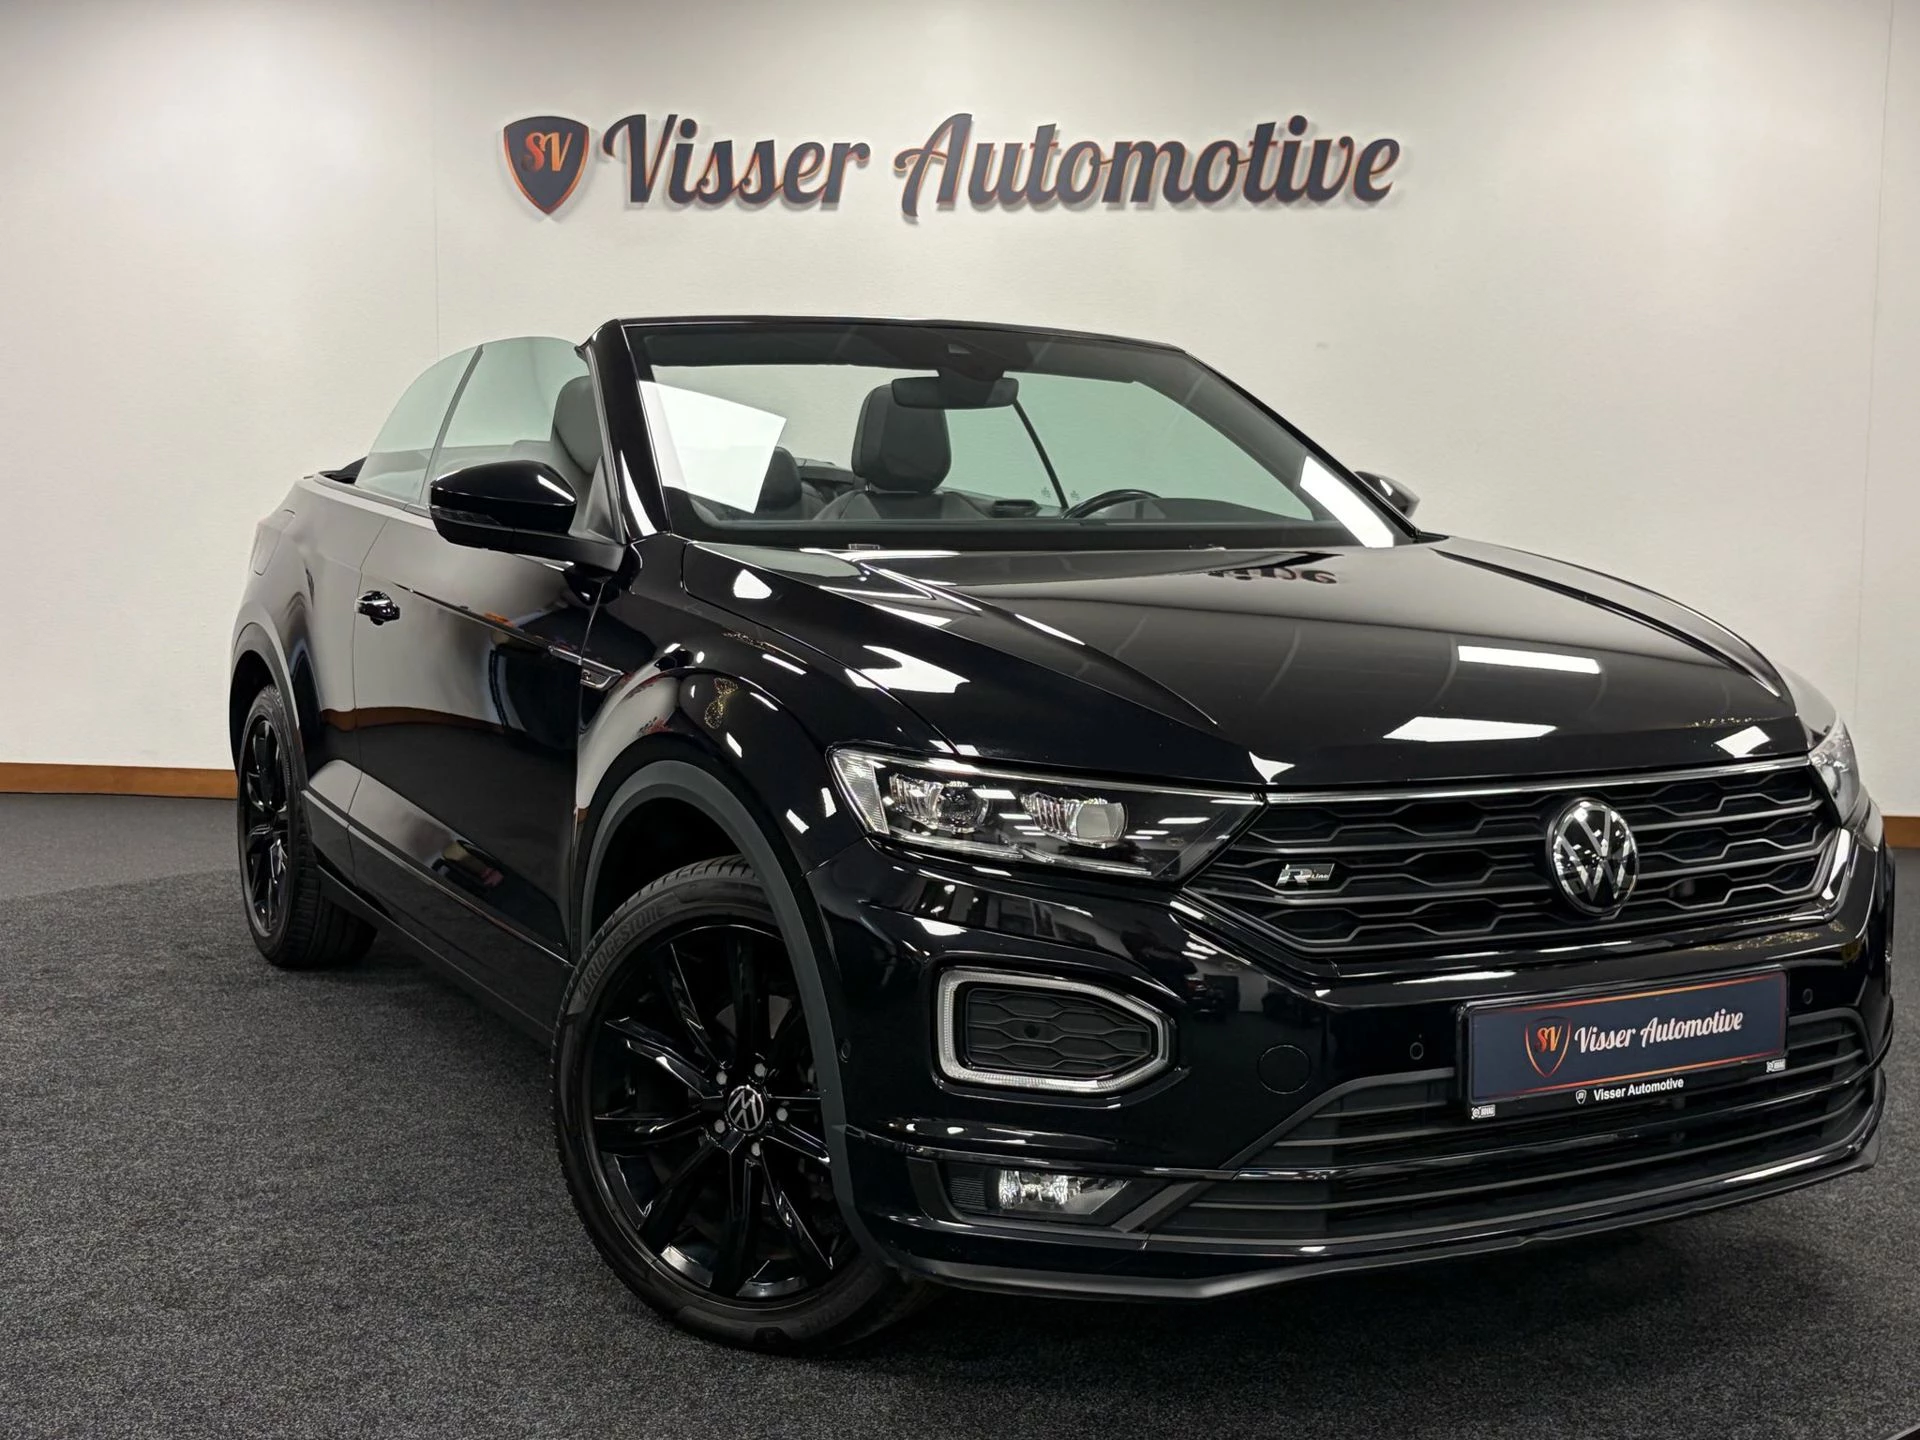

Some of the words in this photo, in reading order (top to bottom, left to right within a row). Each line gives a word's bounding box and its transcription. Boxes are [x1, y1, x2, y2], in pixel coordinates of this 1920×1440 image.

[521, 131, 573, 172] SV
[602, 113, 871, 204] Visser
[893, 112, 1400, 217] Automotive
[1534, 1024, 1563, 1053] SV
[1574, 1026, 1636, 1054] Visser
[1639, 1007, 1744, 1048] Automotive
[1593, 1087, 1626, 1101] Visser
[1627, 1078, 1684, 1097] Automotive
